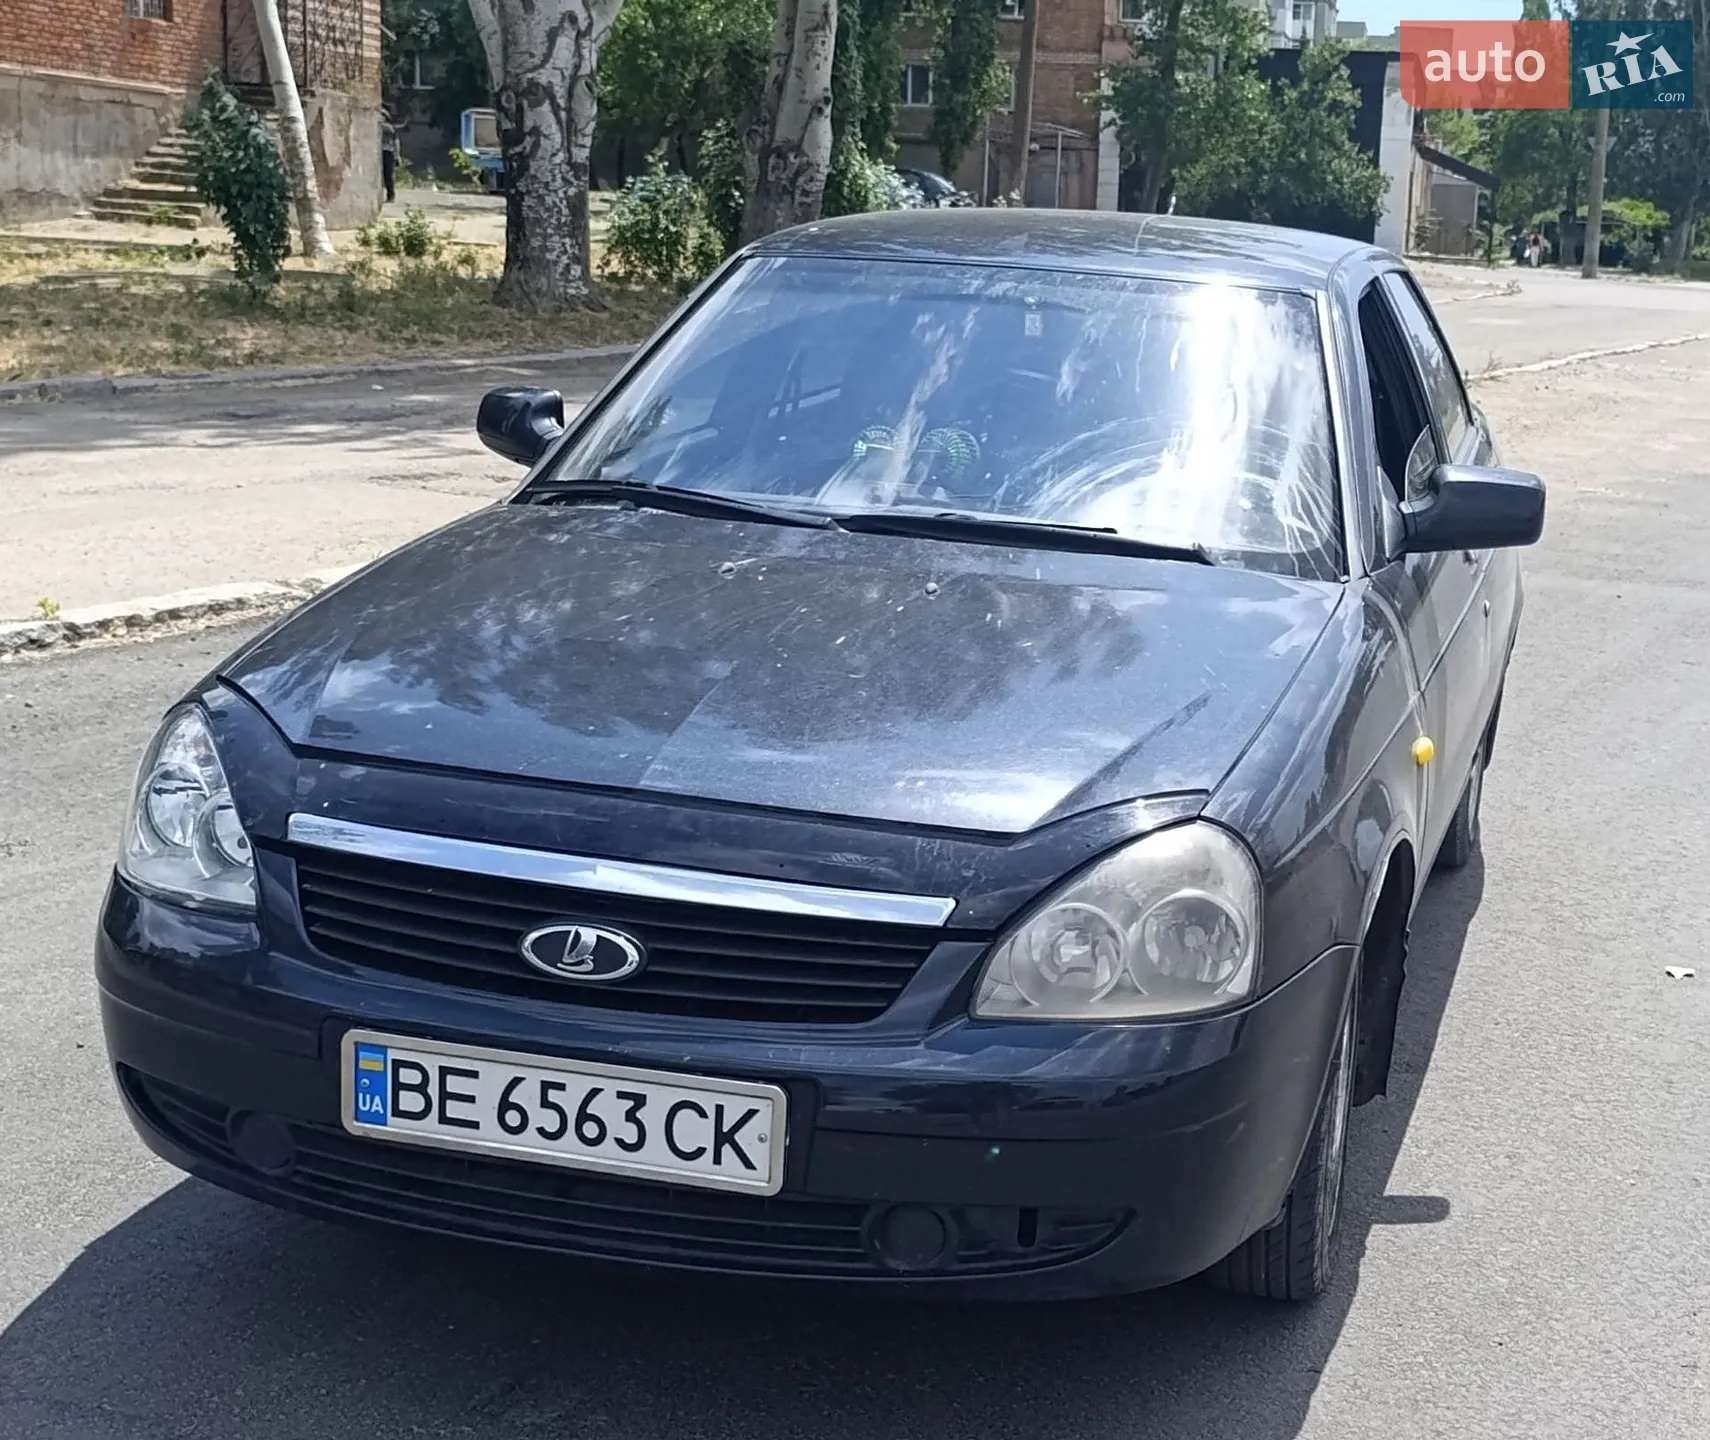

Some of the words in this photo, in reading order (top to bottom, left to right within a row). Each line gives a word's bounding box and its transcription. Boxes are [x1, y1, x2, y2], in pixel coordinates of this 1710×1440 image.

[358, 1093, 384, 1115] UA
[390, 1058, 480, 1130] BE
[497, 1076, 647, 1153] 6563
[664, 1100, 760, 1171] CK
